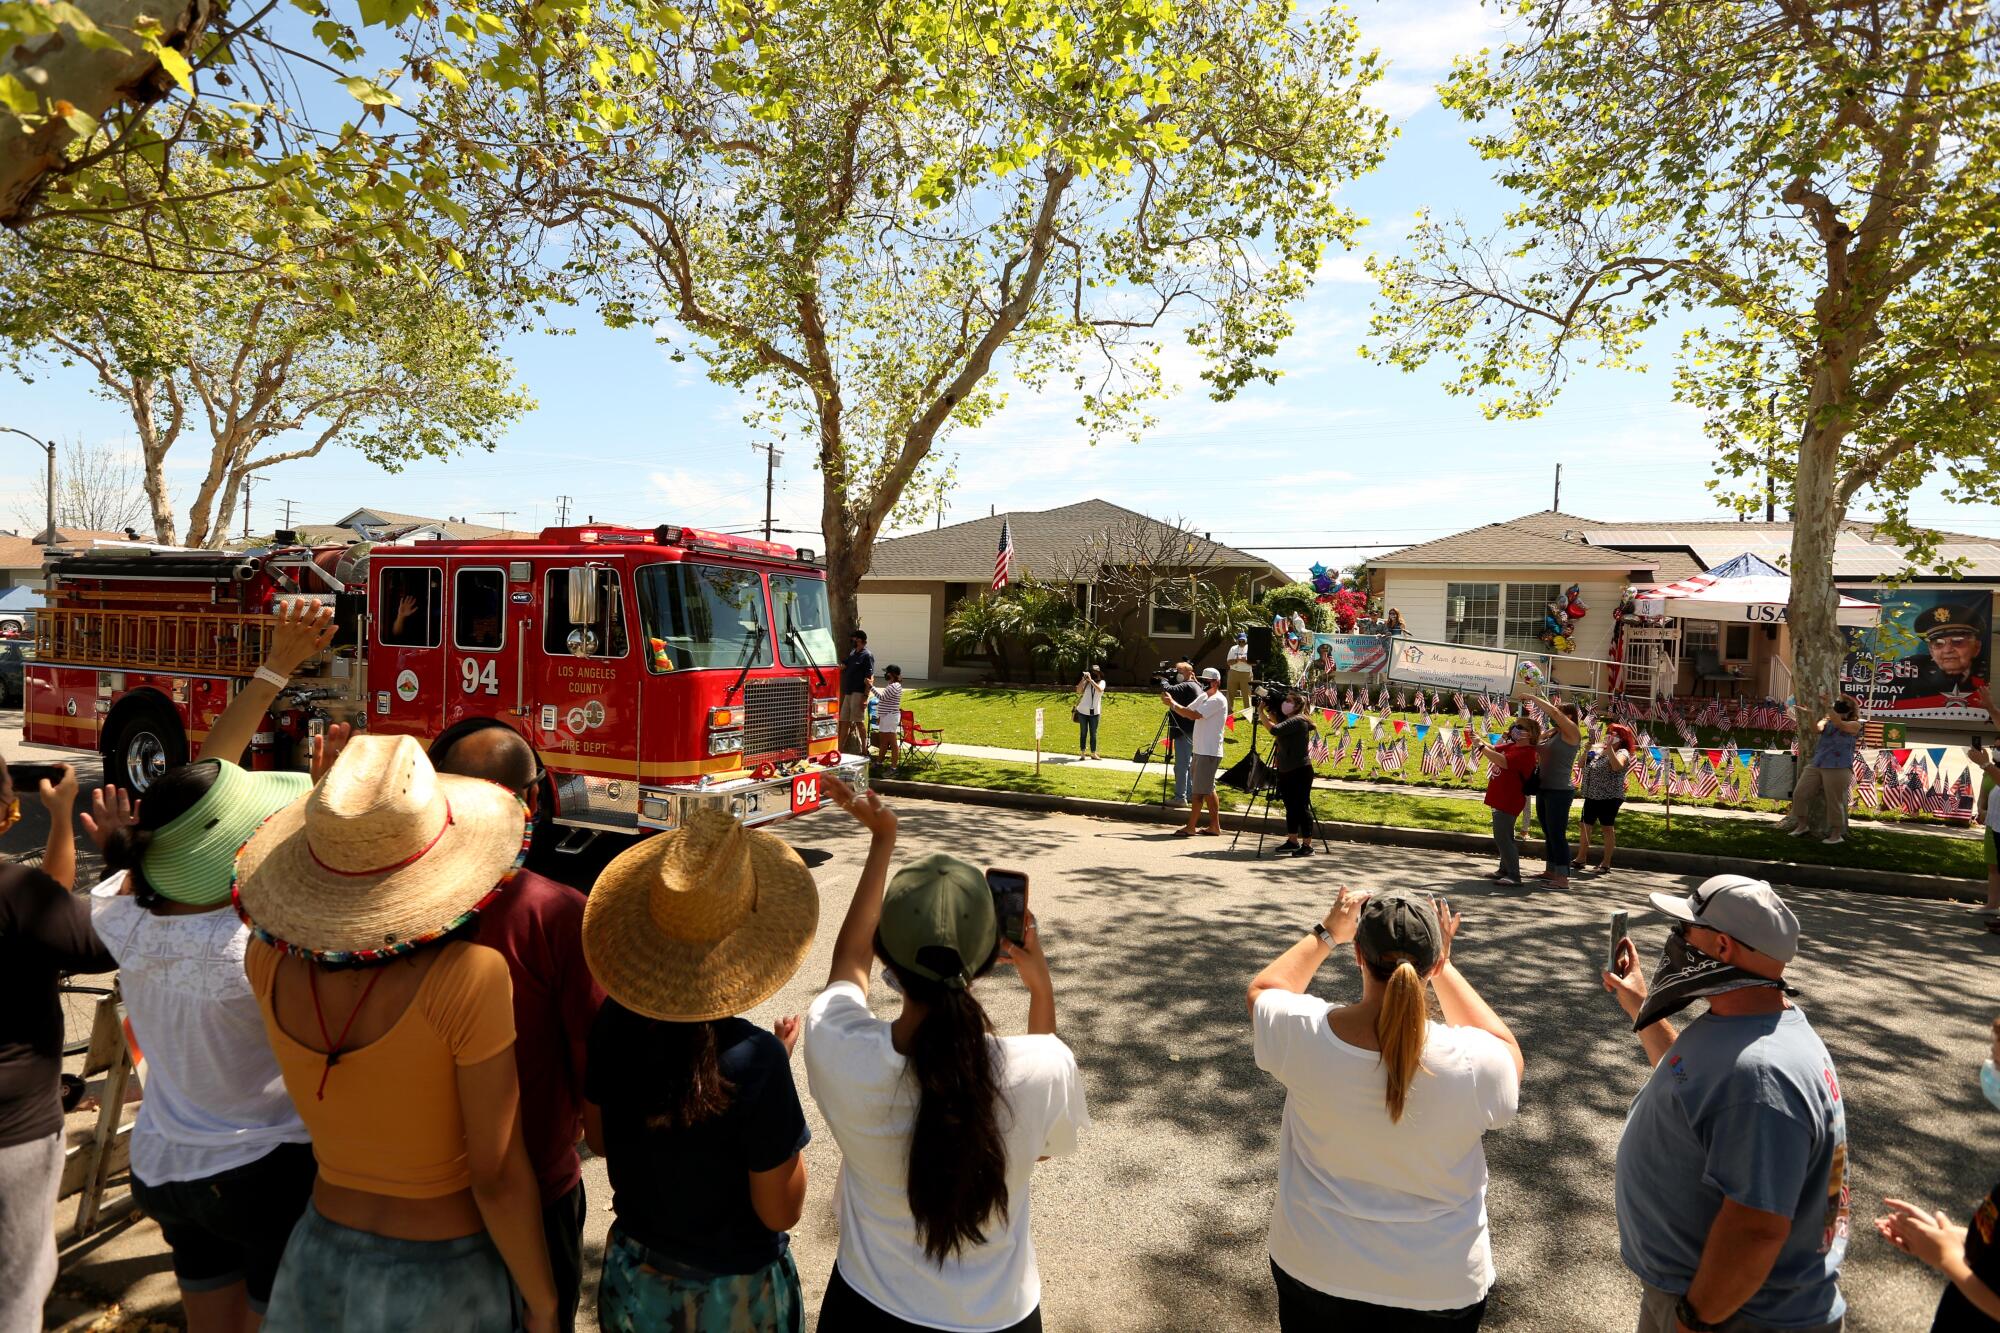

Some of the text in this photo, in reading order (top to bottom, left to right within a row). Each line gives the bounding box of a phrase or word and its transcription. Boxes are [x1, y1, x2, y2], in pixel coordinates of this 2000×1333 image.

[1746, 605, 1789, 622] USA
[461, 657, 499, 695] 94
[558, 665, 616, 680] LOS ANGELES
[1840, 660, 1919, 683] 105th
[568, 682, 604, 694] COUNTY
[1845, 684, 1905, 694] BIRTHDAY
[1856, 694, 1896, 708] Sam!
[561, 740, 610, 754] FIRE DEPT.
[796, 779, 817, 805] 94
